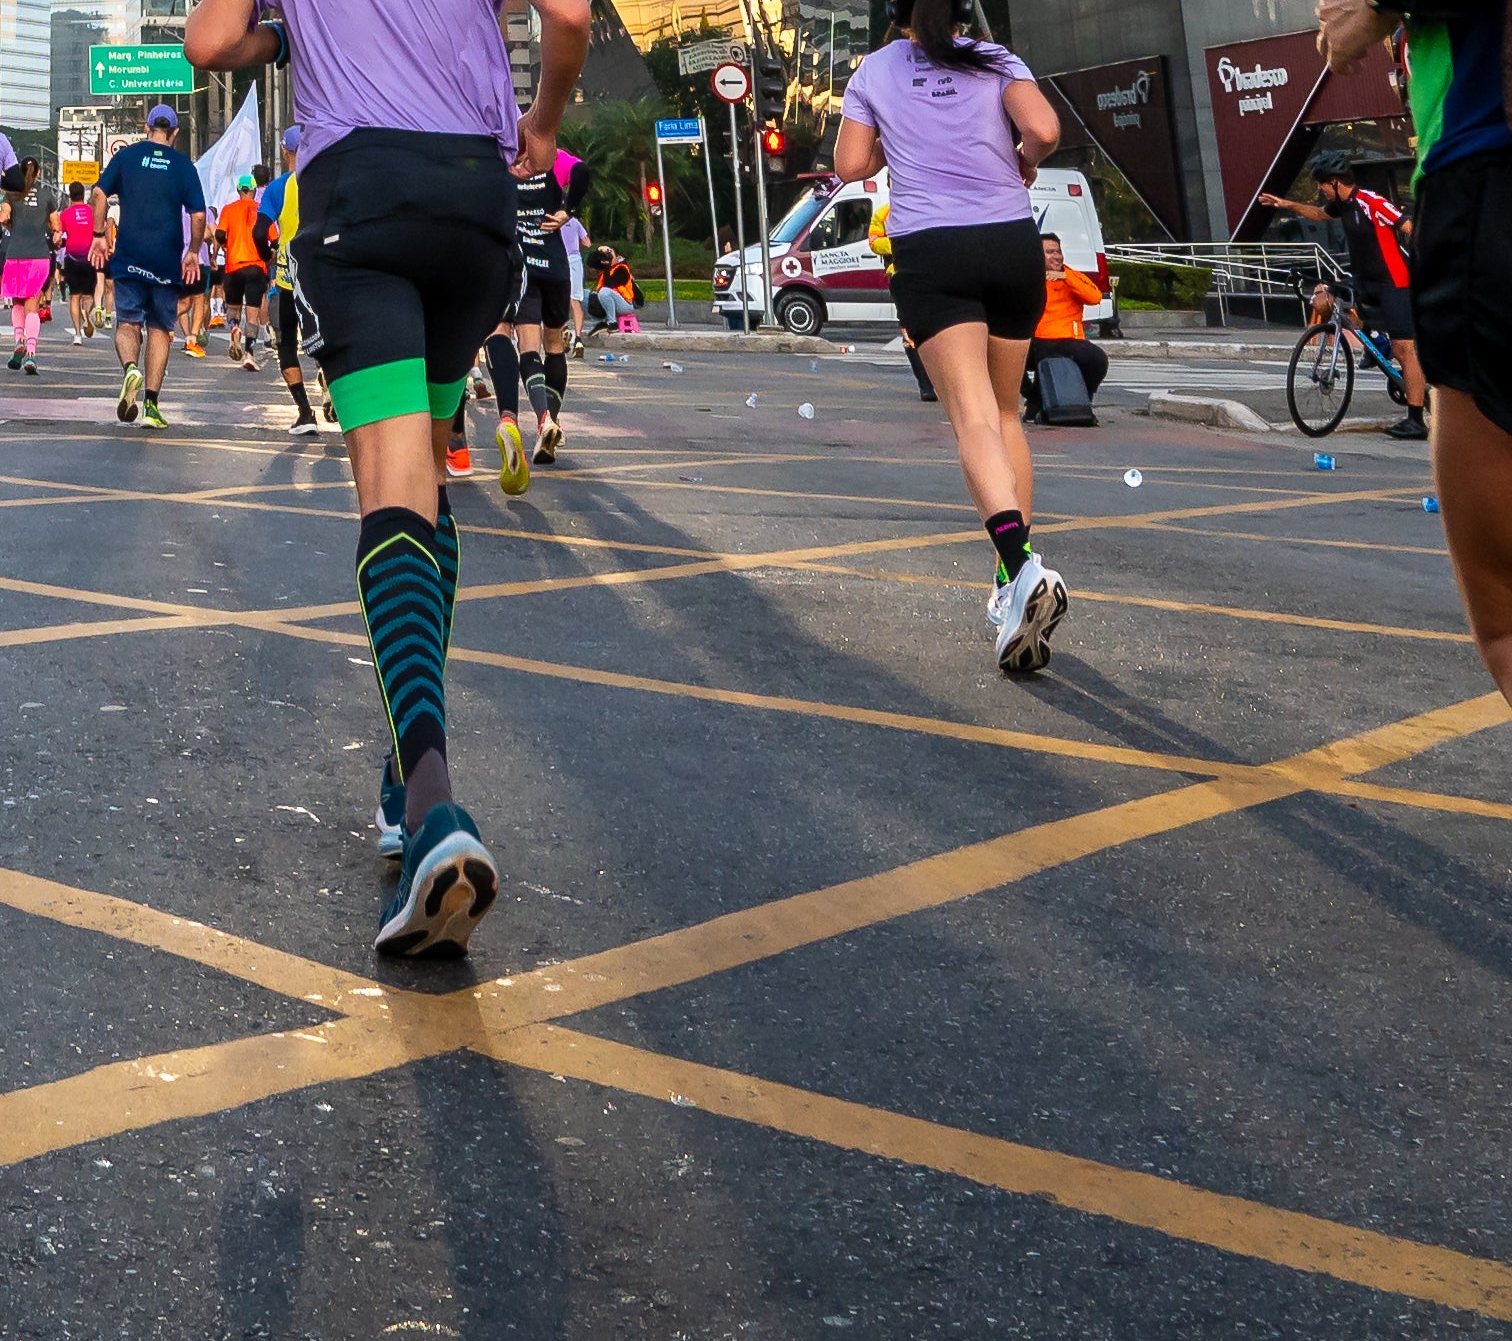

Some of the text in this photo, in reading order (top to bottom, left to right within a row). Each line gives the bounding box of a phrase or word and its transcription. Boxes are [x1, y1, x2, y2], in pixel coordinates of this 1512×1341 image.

[108, 50, 182, 61] Marq. Pinheiros
[108, 65, 150, 74] Morumbi
[108, 78, 184, 88] C. Universitária
[659, 121, 678, 131] Faria
